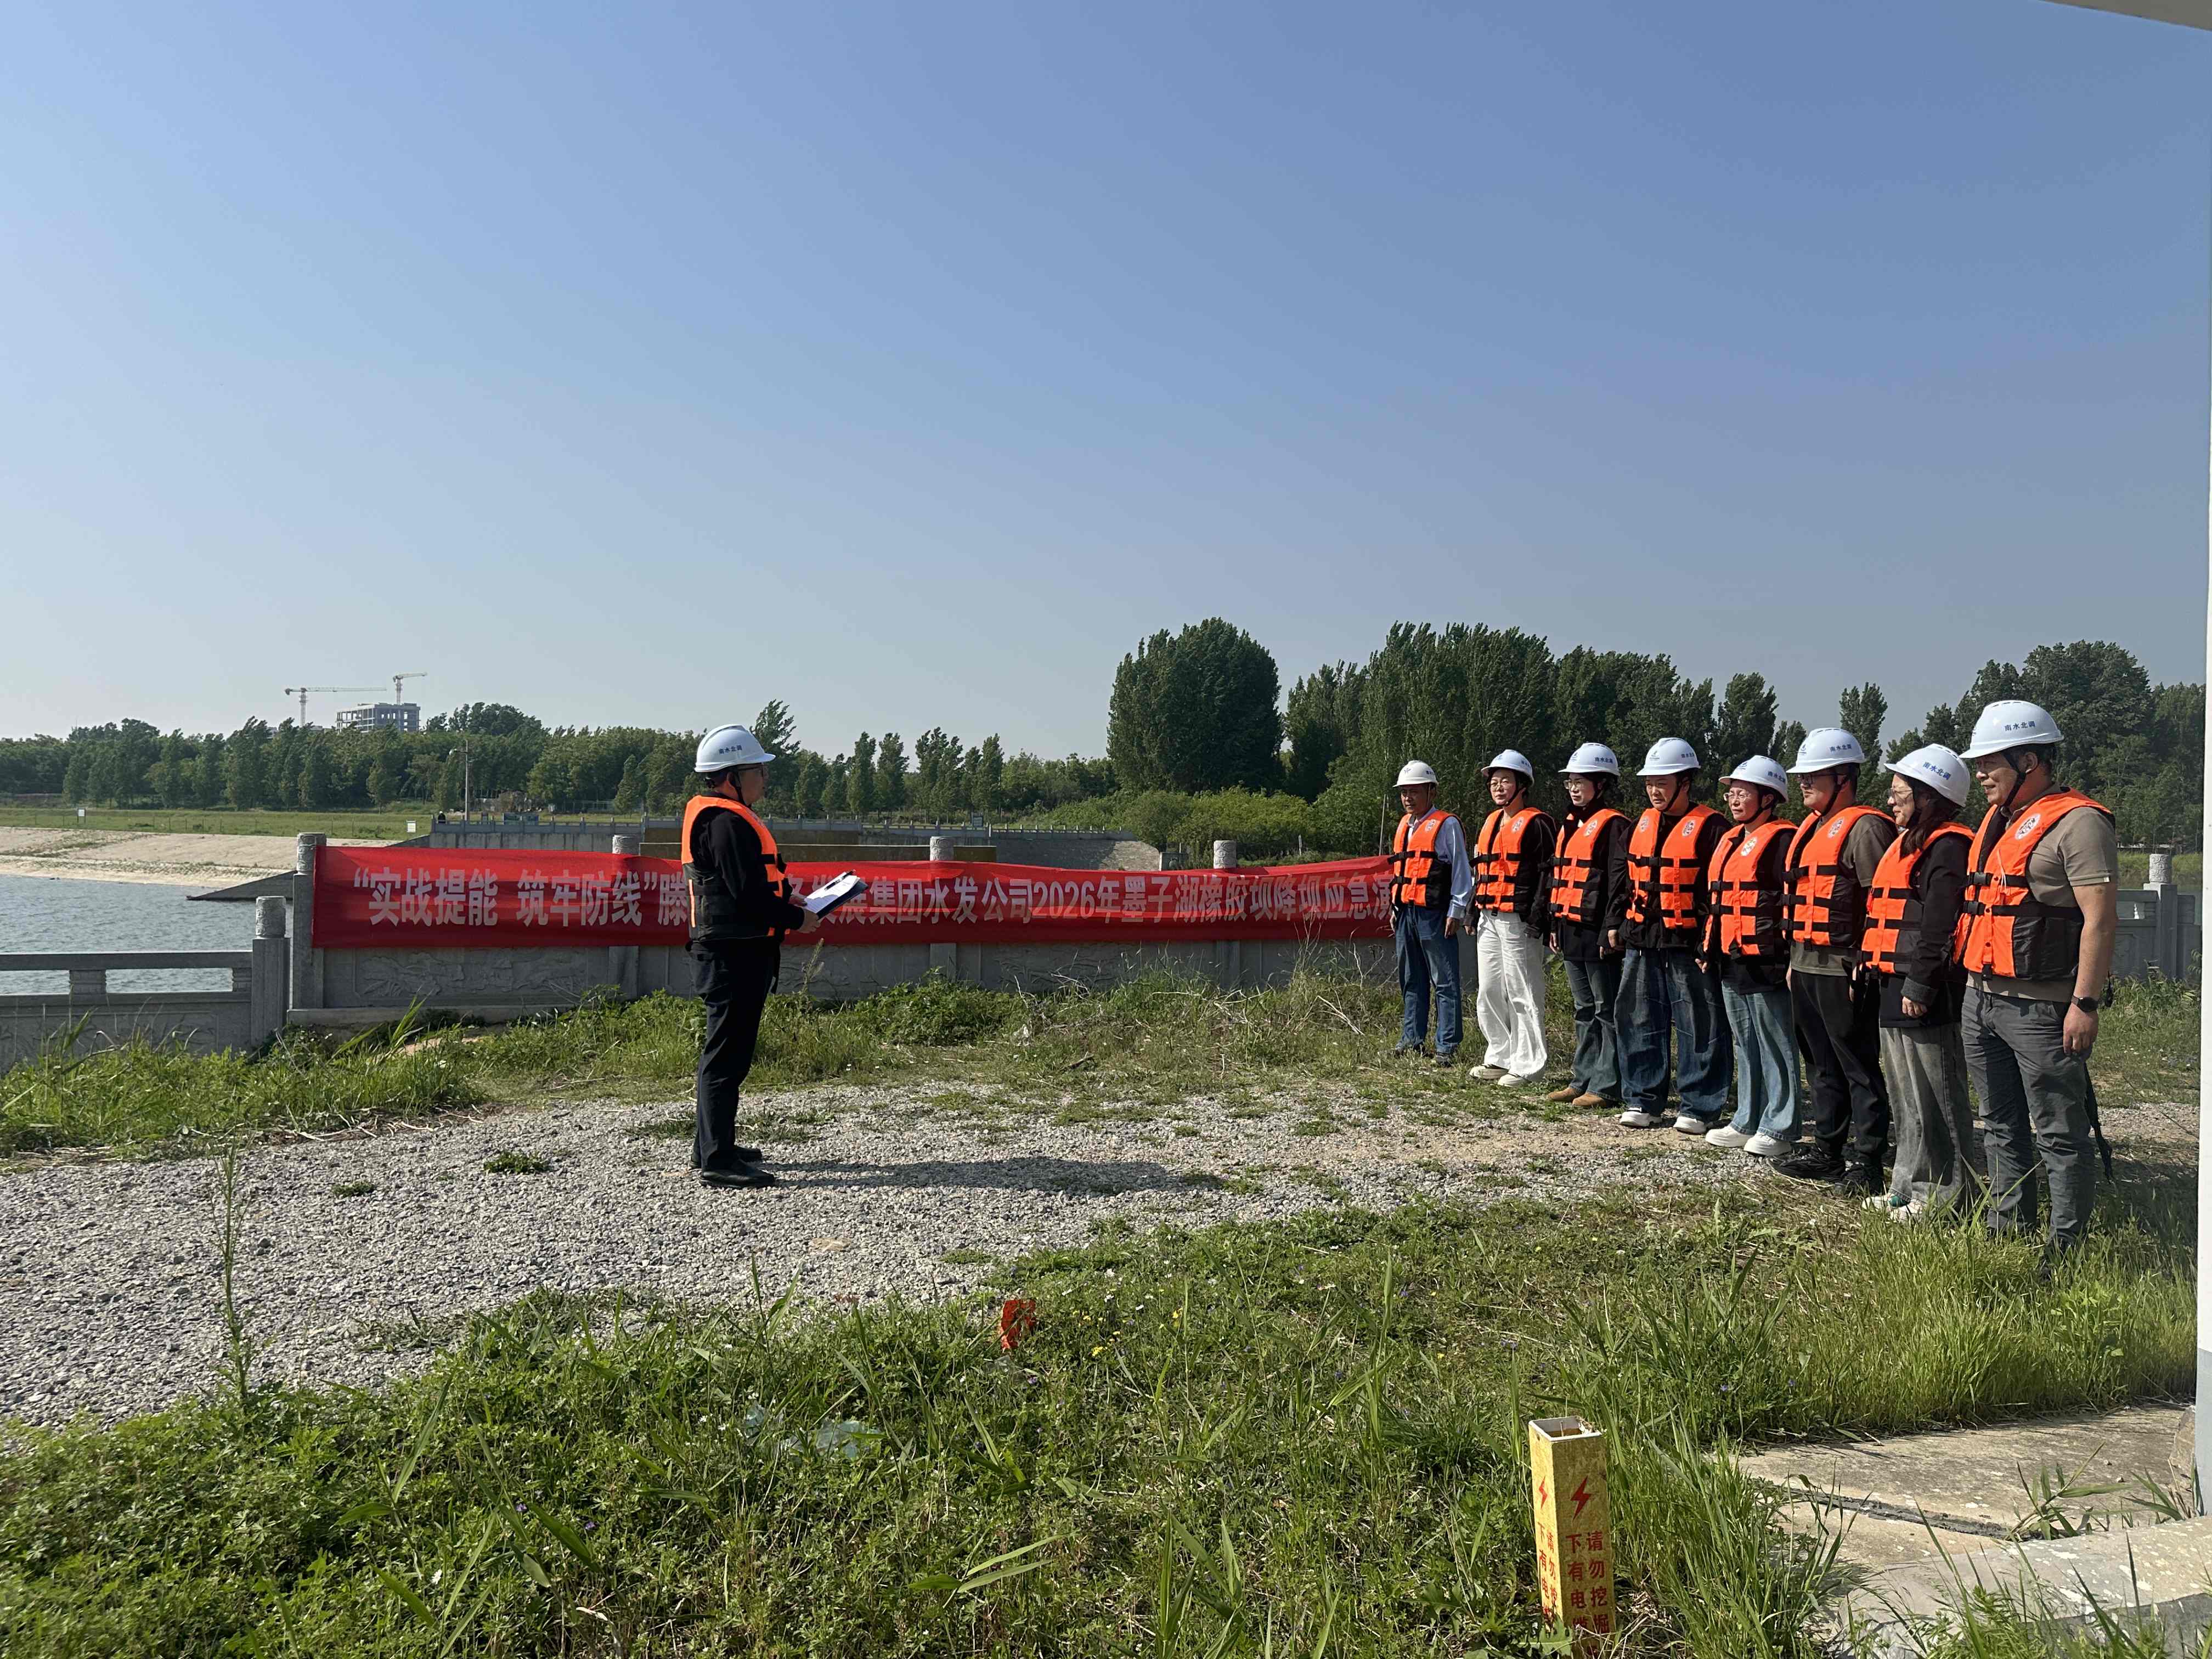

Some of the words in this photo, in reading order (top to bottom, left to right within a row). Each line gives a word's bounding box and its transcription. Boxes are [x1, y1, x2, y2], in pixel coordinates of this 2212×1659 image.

[2005, 721, 2036, 731] 南水北调
[1922, 761, 1951, 780] 南水北调
[353, 867, 499, 927] “实战提能
